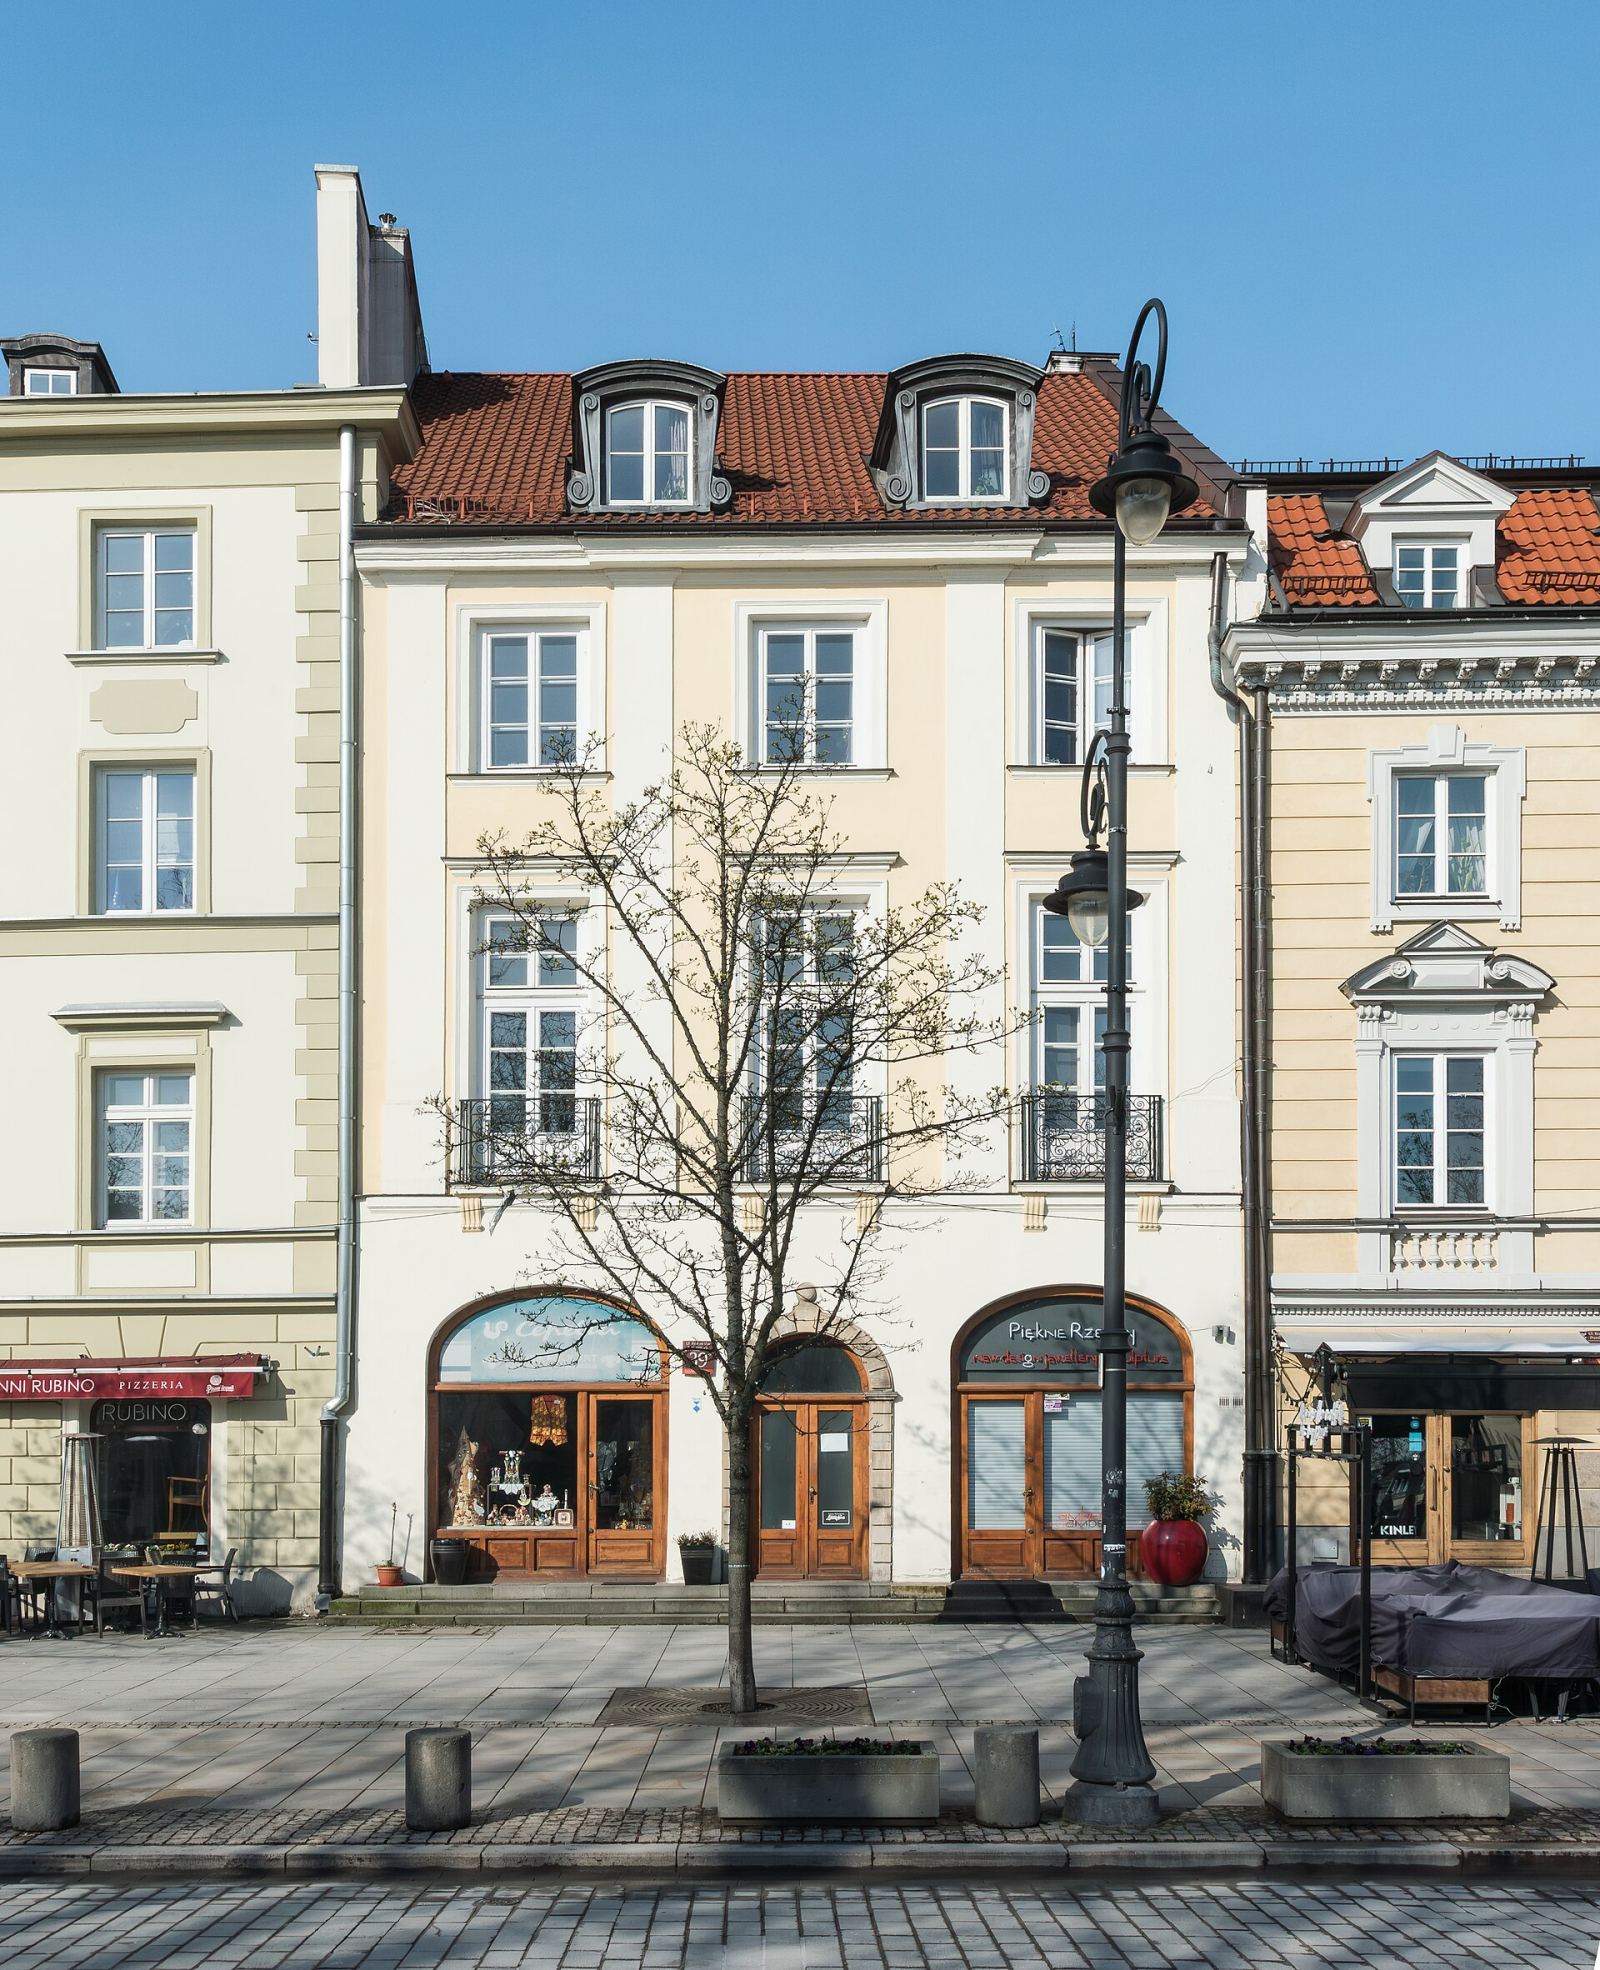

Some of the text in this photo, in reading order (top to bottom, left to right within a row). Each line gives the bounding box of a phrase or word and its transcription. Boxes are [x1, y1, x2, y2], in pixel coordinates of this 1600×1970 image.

[1070, 1322, 1136, 1346] Rzey
[32, 1379, 95, 1393] RUBINO
[119, 1381, 184, 1390] PIZZERIA
[102, 1403, 187, 1421] RUBINO
